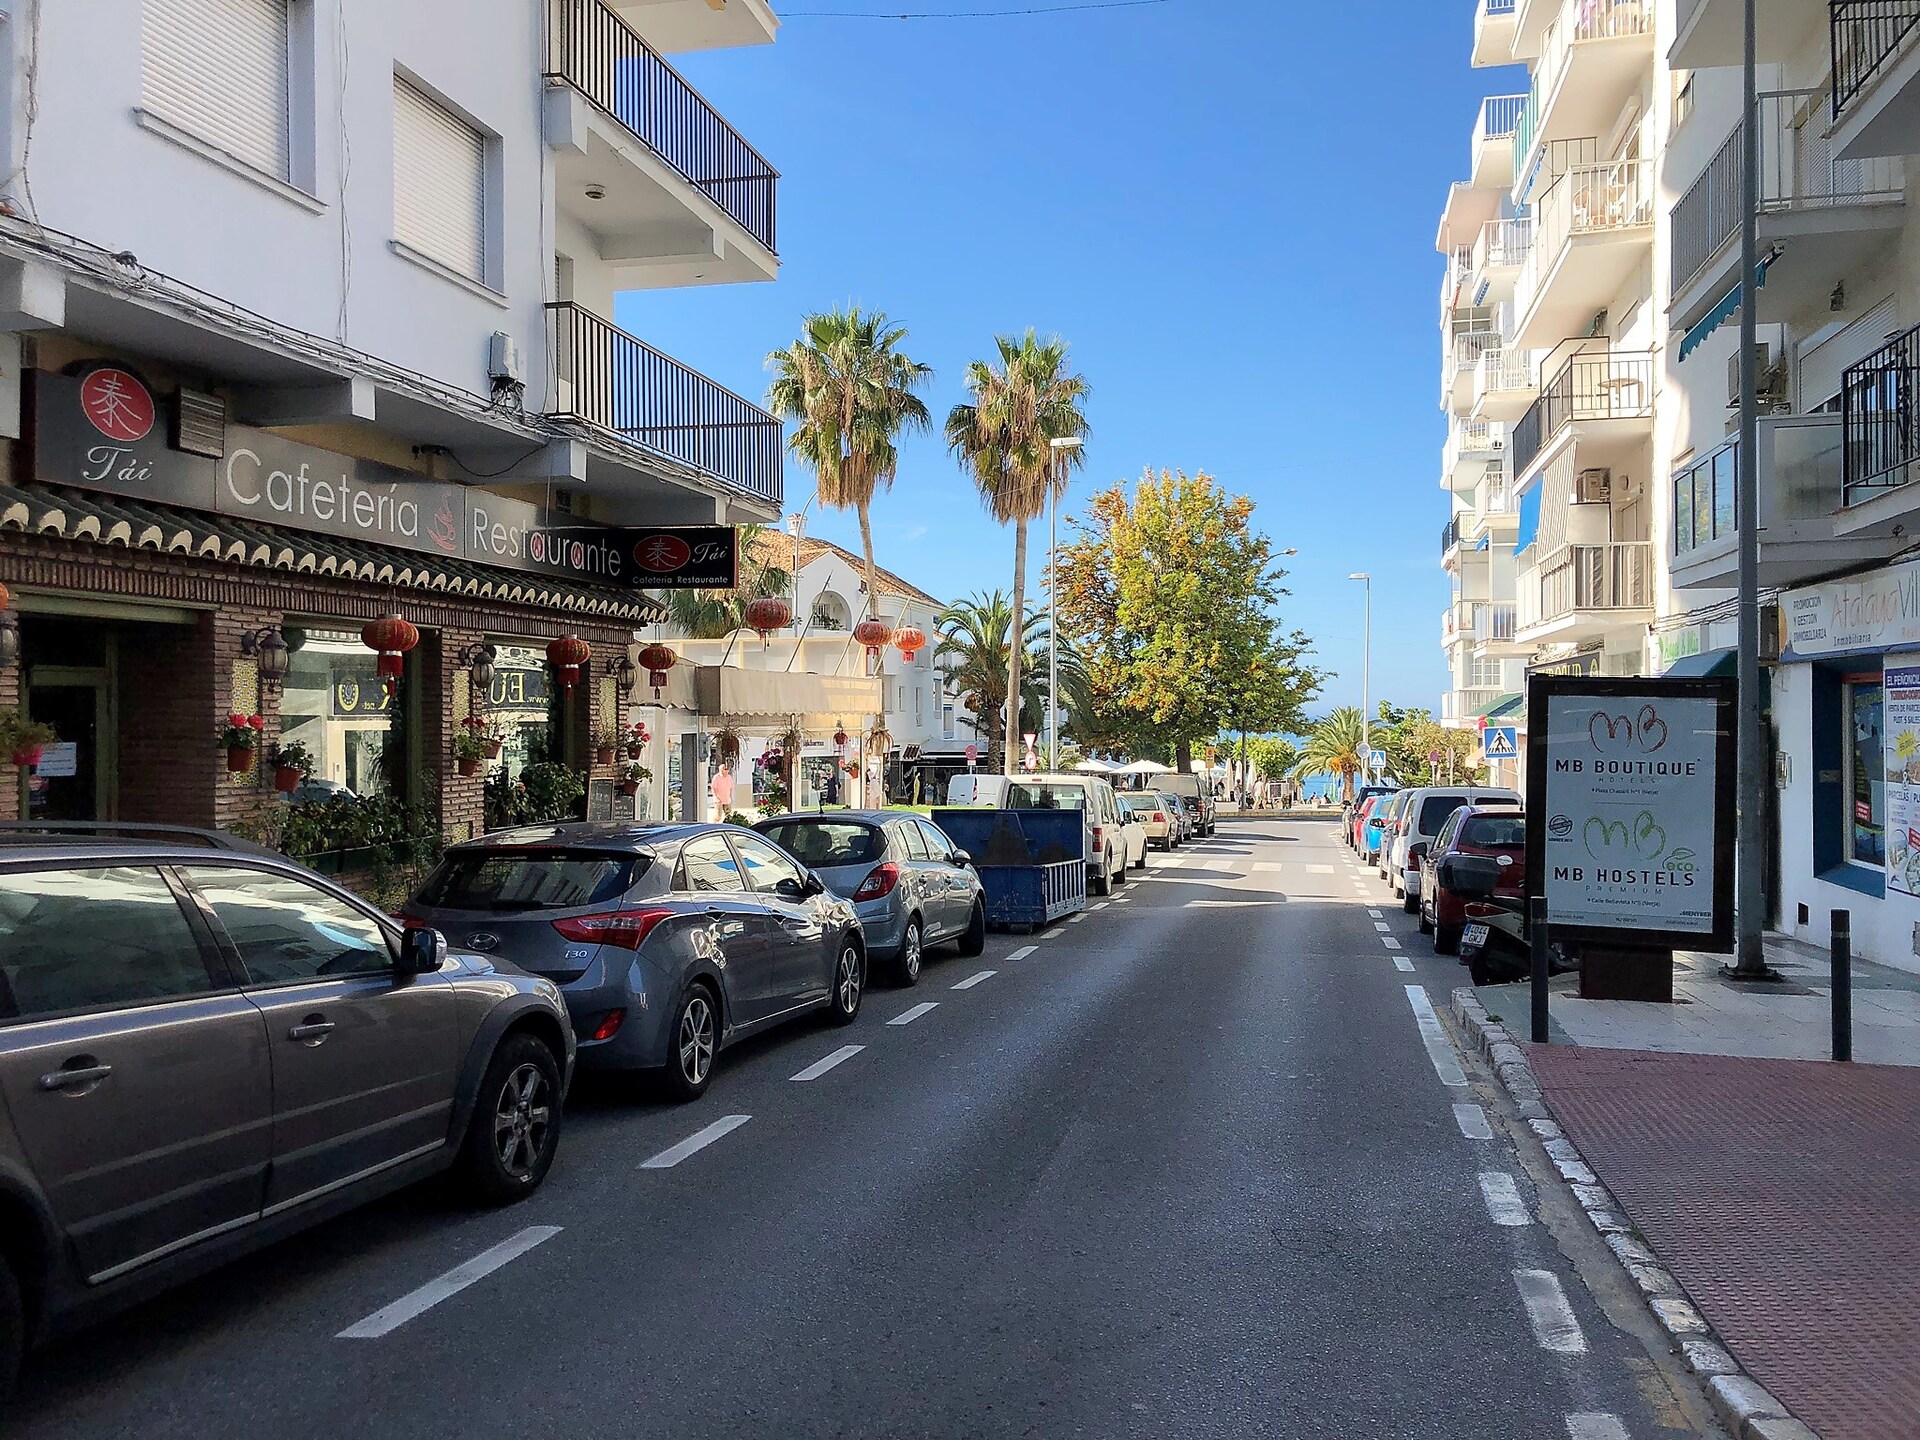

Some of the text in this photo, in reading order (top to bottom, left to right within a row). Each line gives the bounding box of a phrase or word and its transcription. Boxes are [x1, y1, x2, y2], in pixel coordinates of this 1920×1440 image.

[82, 445, 153, 482] Tái
[226, 448, 622, 577] Cafetería Restaurante
[692, 541, 729, 564] Tái
[677, 575, 729, 585] Restaurante
[1555, 759, 1696, 776] MB BOUTIQUE
[1666, 861, 1694, 872] eco
[1554, 866, 1695, 887] MB HOSTELS
[1585, 885, 1662, 895] PREMIUM
[564, 950, 588, 959] i30
